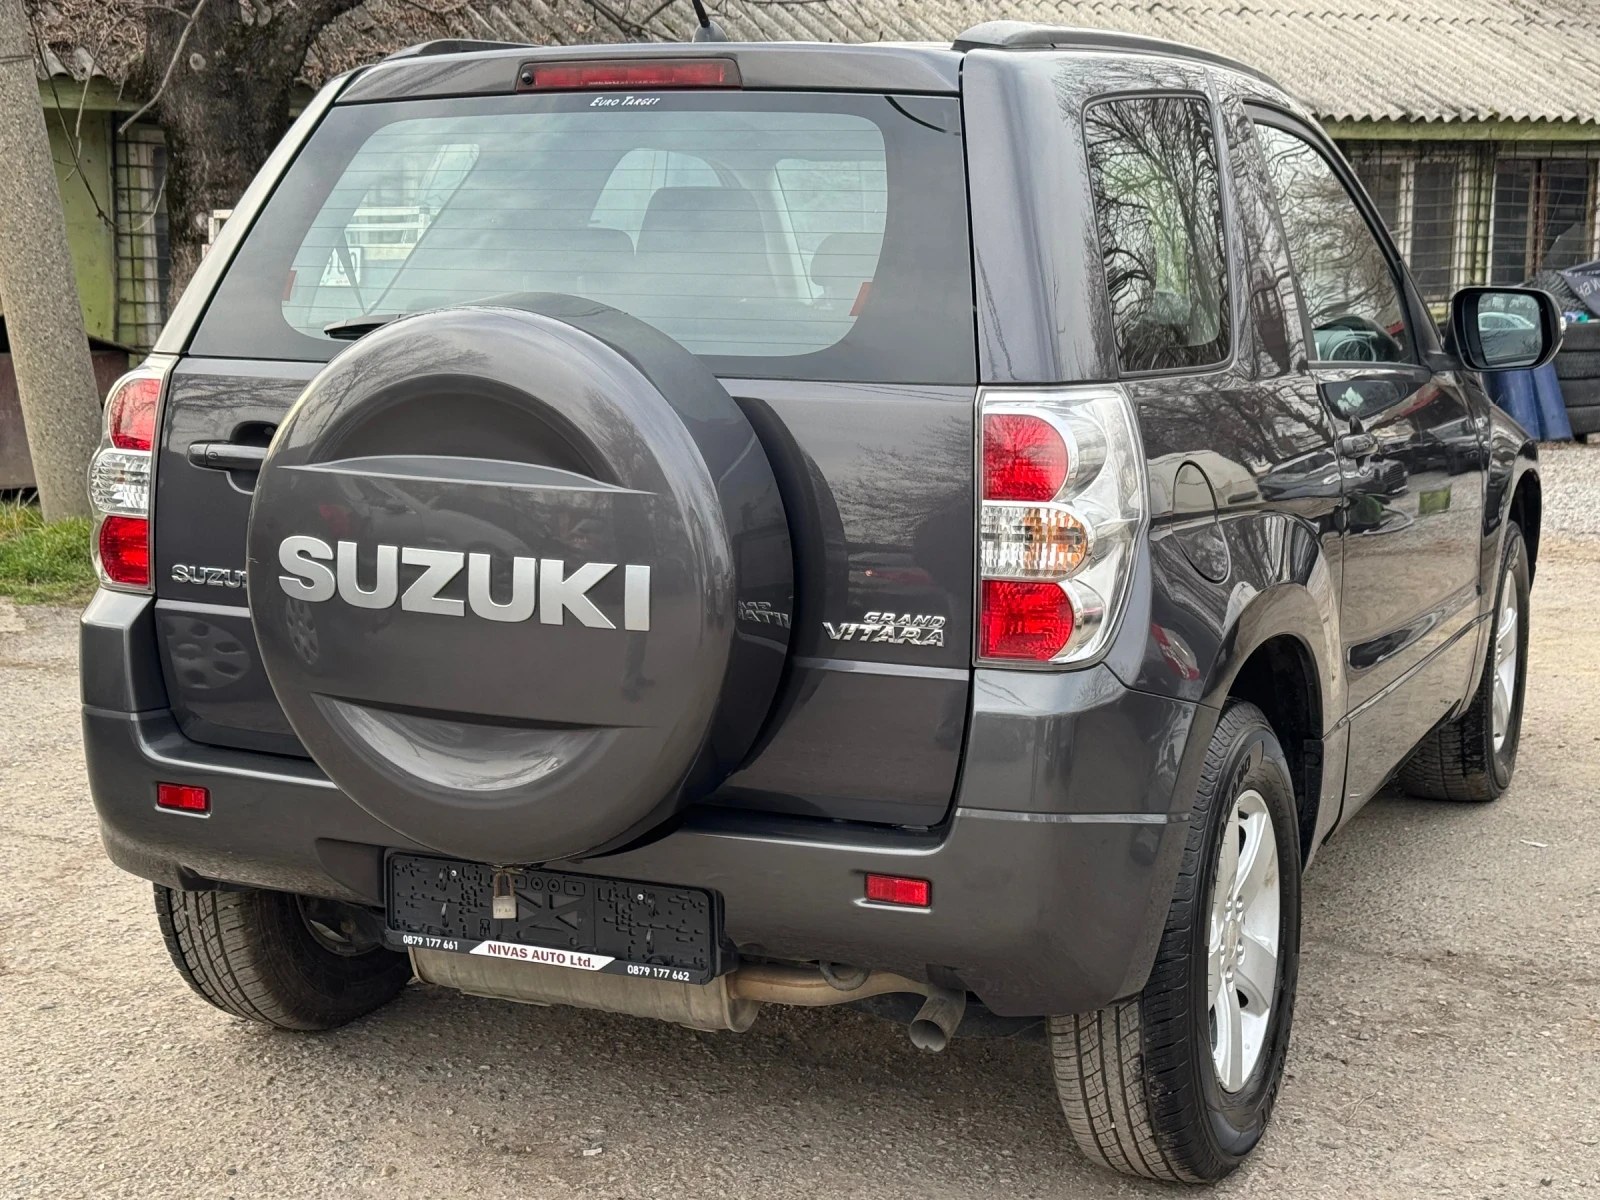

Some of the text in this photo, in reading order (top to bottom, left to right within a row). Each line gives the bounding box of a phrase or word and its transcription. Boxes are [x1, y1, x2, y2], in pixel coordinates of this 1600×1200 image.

[278, 535, 651, 632] SUZUKI
[863, 611, 946, 629] GRAND
[822, 622, 945, 648] VITARA
[402, 935, 458, 951] 0879 177 661
[487, 943, 596, 968] NIVAS AUTO Ltd.
[627, 964, 690, 982] 0879 177 662
